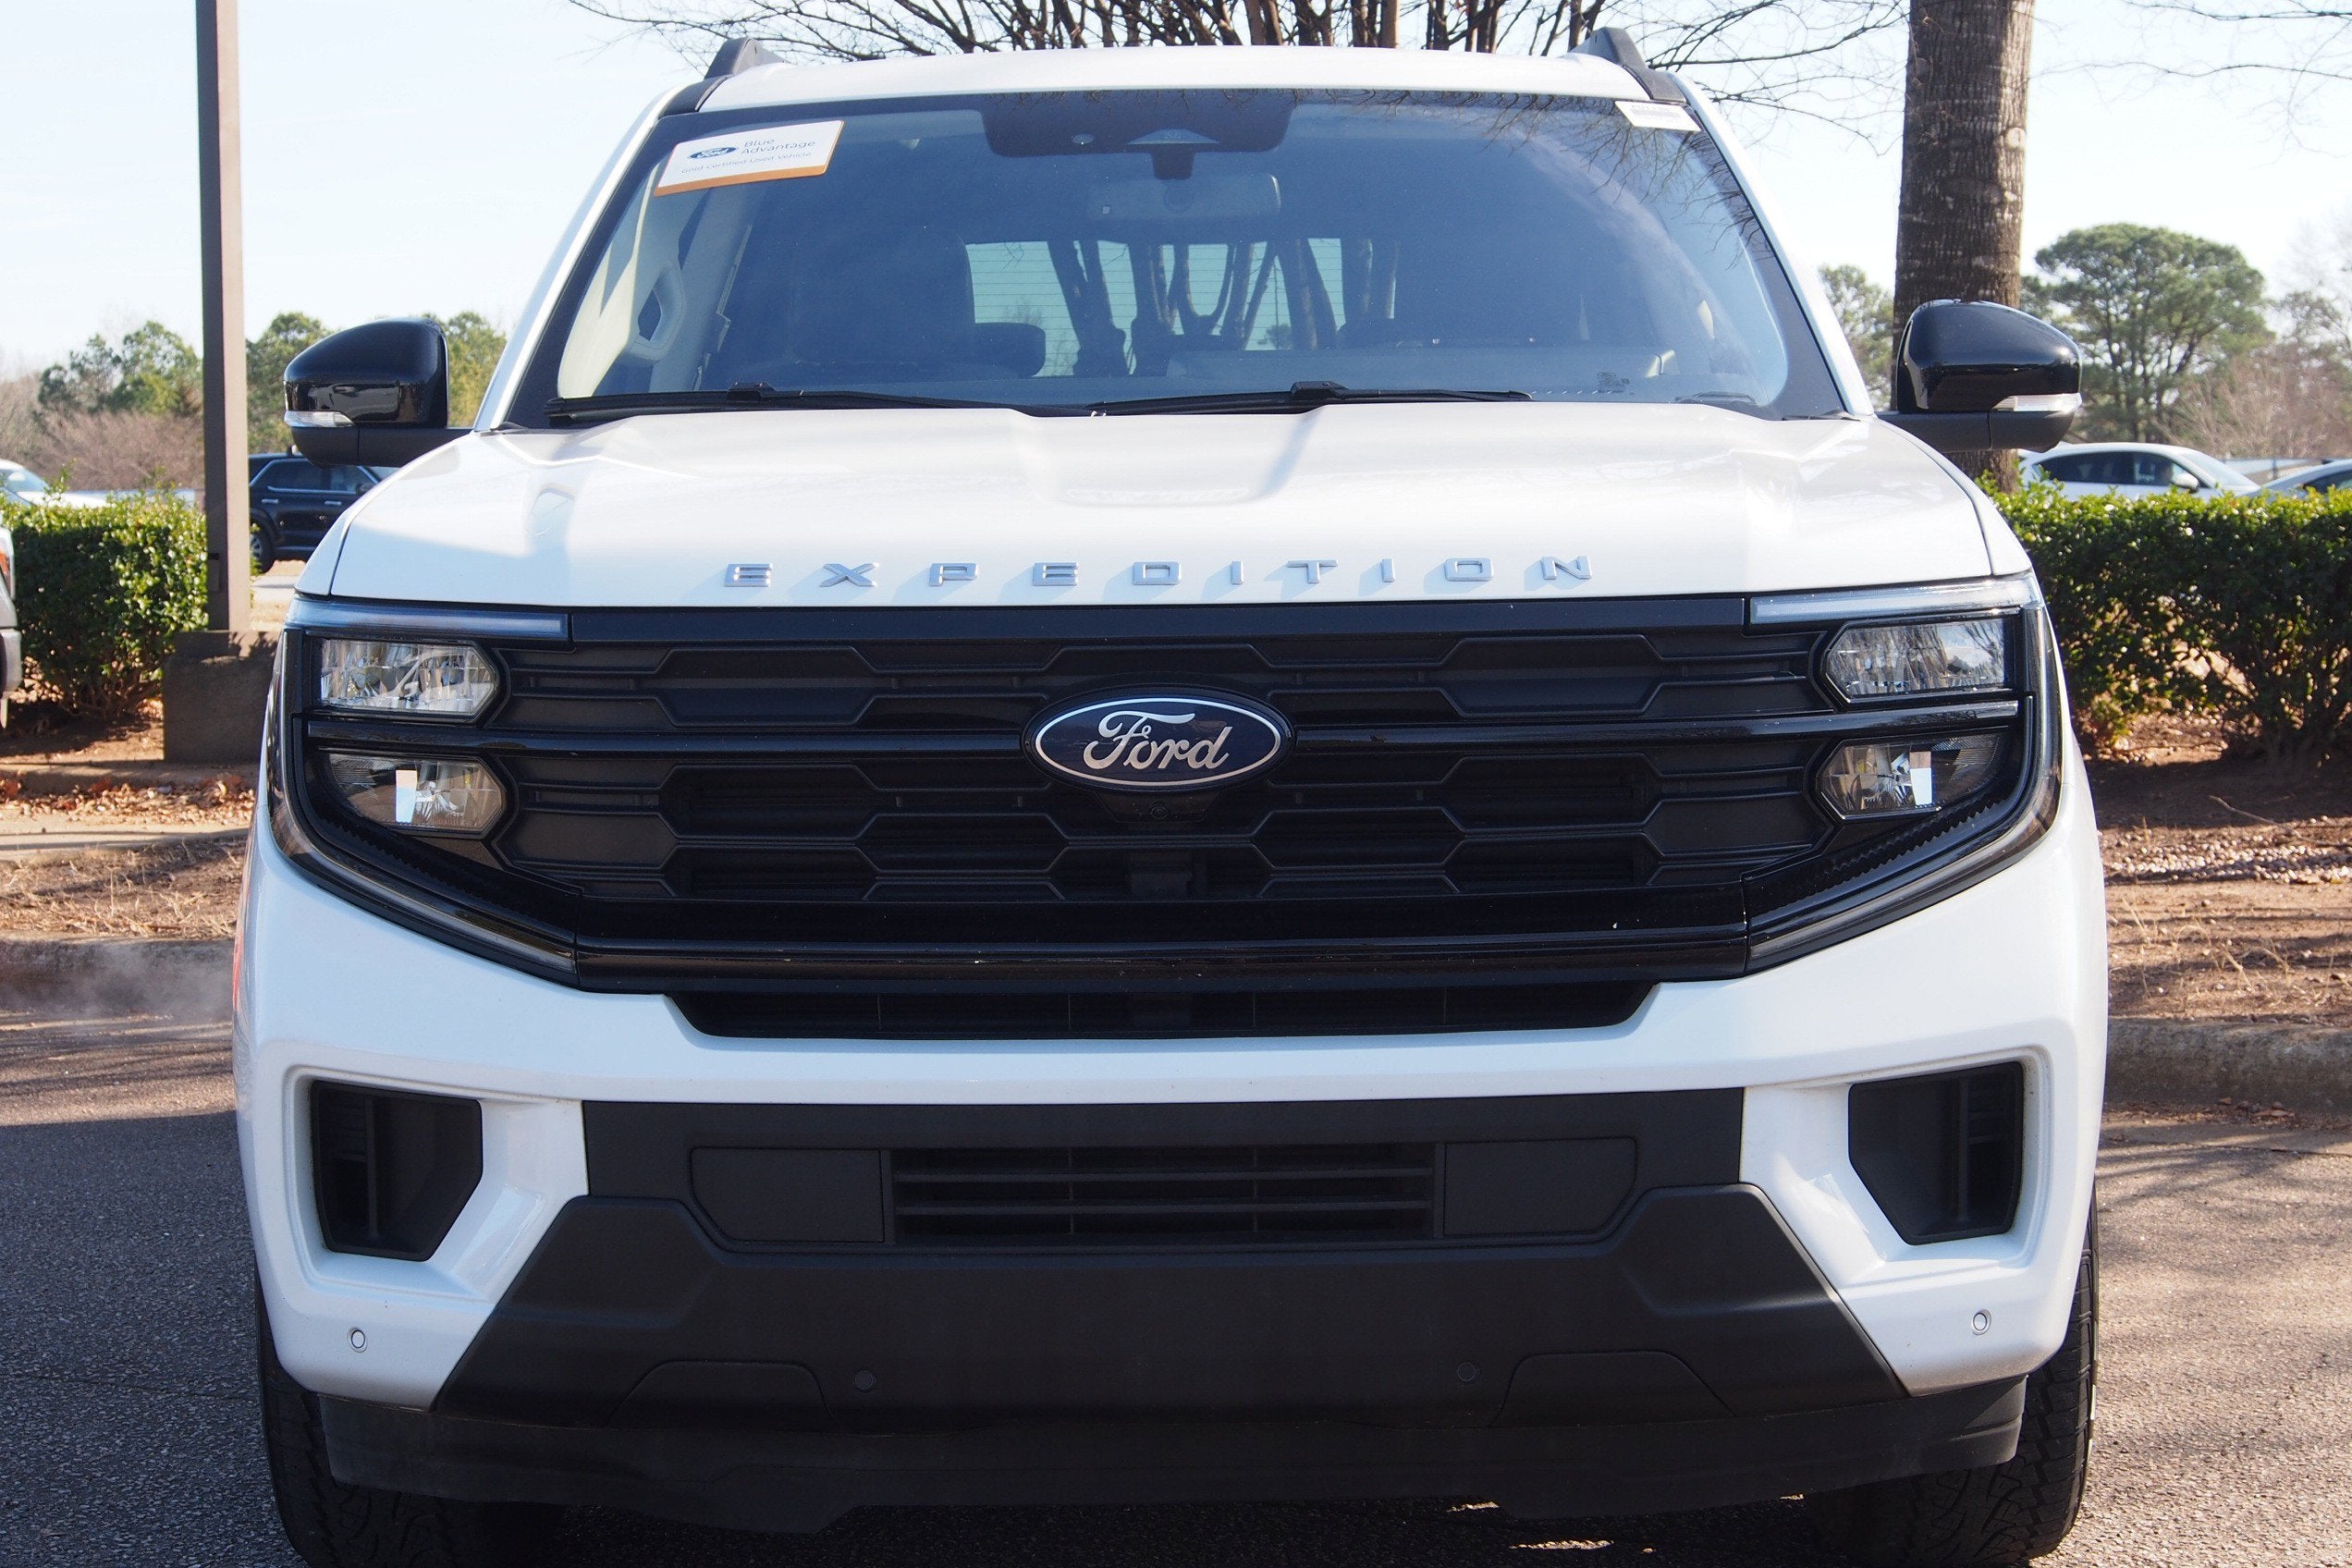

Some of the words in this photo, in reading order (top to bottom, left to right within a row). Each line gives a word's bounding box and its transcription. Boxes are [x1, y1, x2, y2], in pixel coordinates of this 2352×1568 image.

[740, 141, 815, 155] Advantage
[744, 139, 775, 148] Blue
[778, 152, 812, 160] Vehicle
[724, 556, 1592, 587] EXPEDITION
[1083, 710, 1233, 770] Ford
